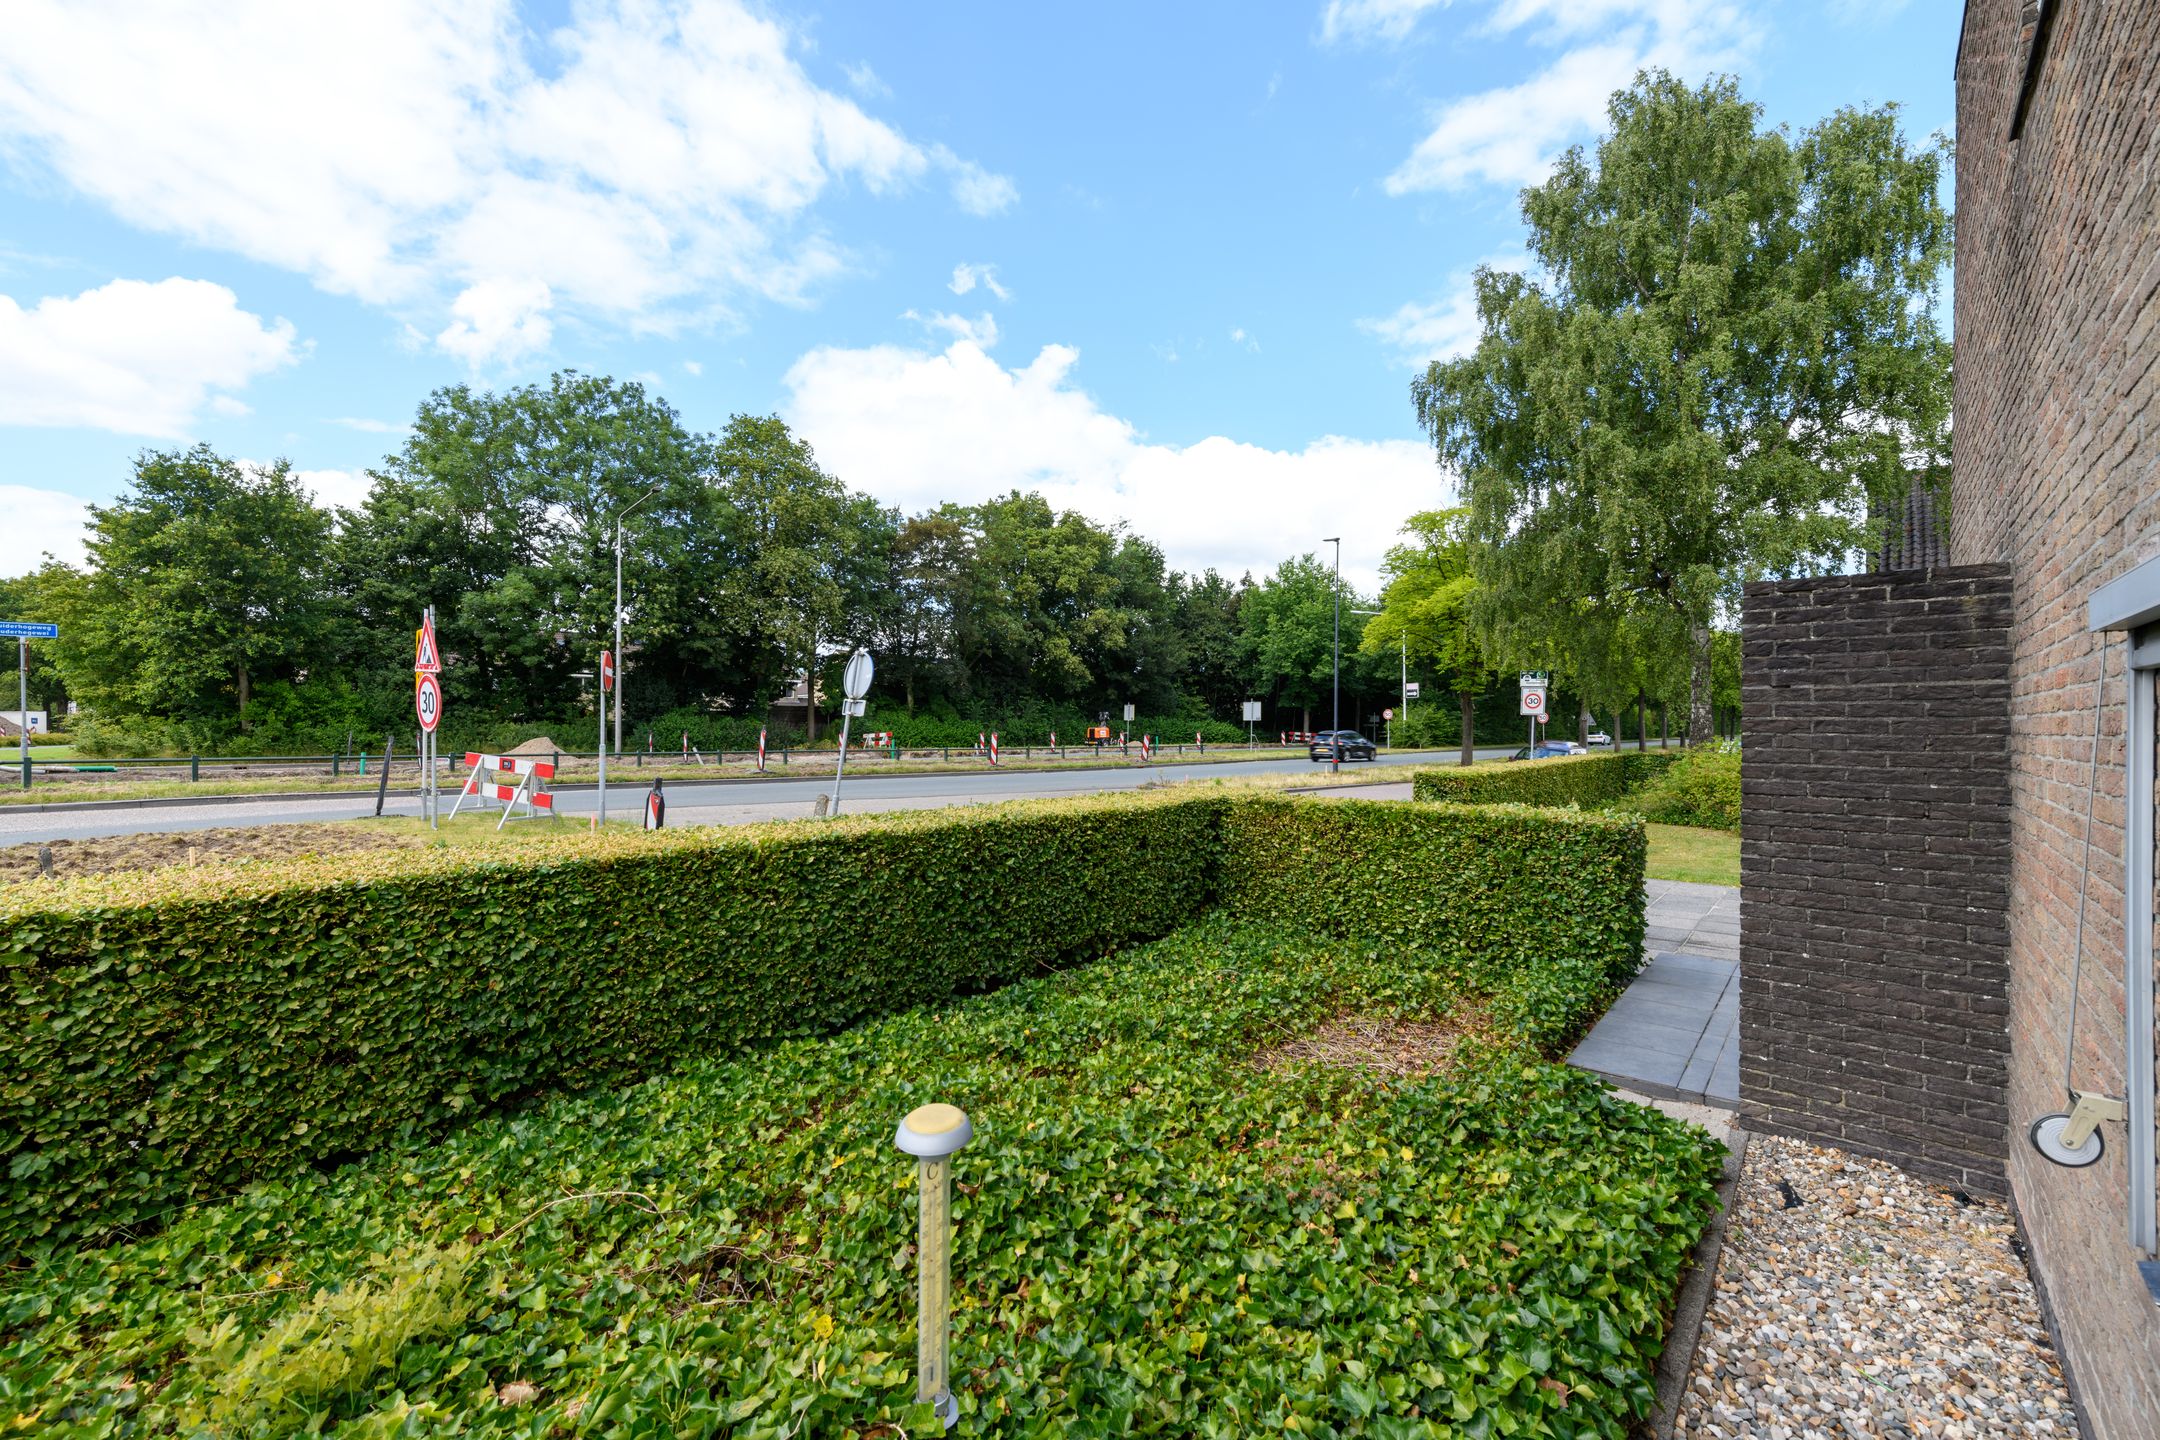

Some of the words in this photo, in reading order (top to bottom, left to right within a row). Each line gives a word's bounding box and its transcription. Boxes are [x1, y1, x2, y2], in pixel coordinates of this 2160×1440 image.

[422, 691, 435, 714] 30
[1527, 697, 1539, 705] 30
[927, 1162, 939, 1180] C
